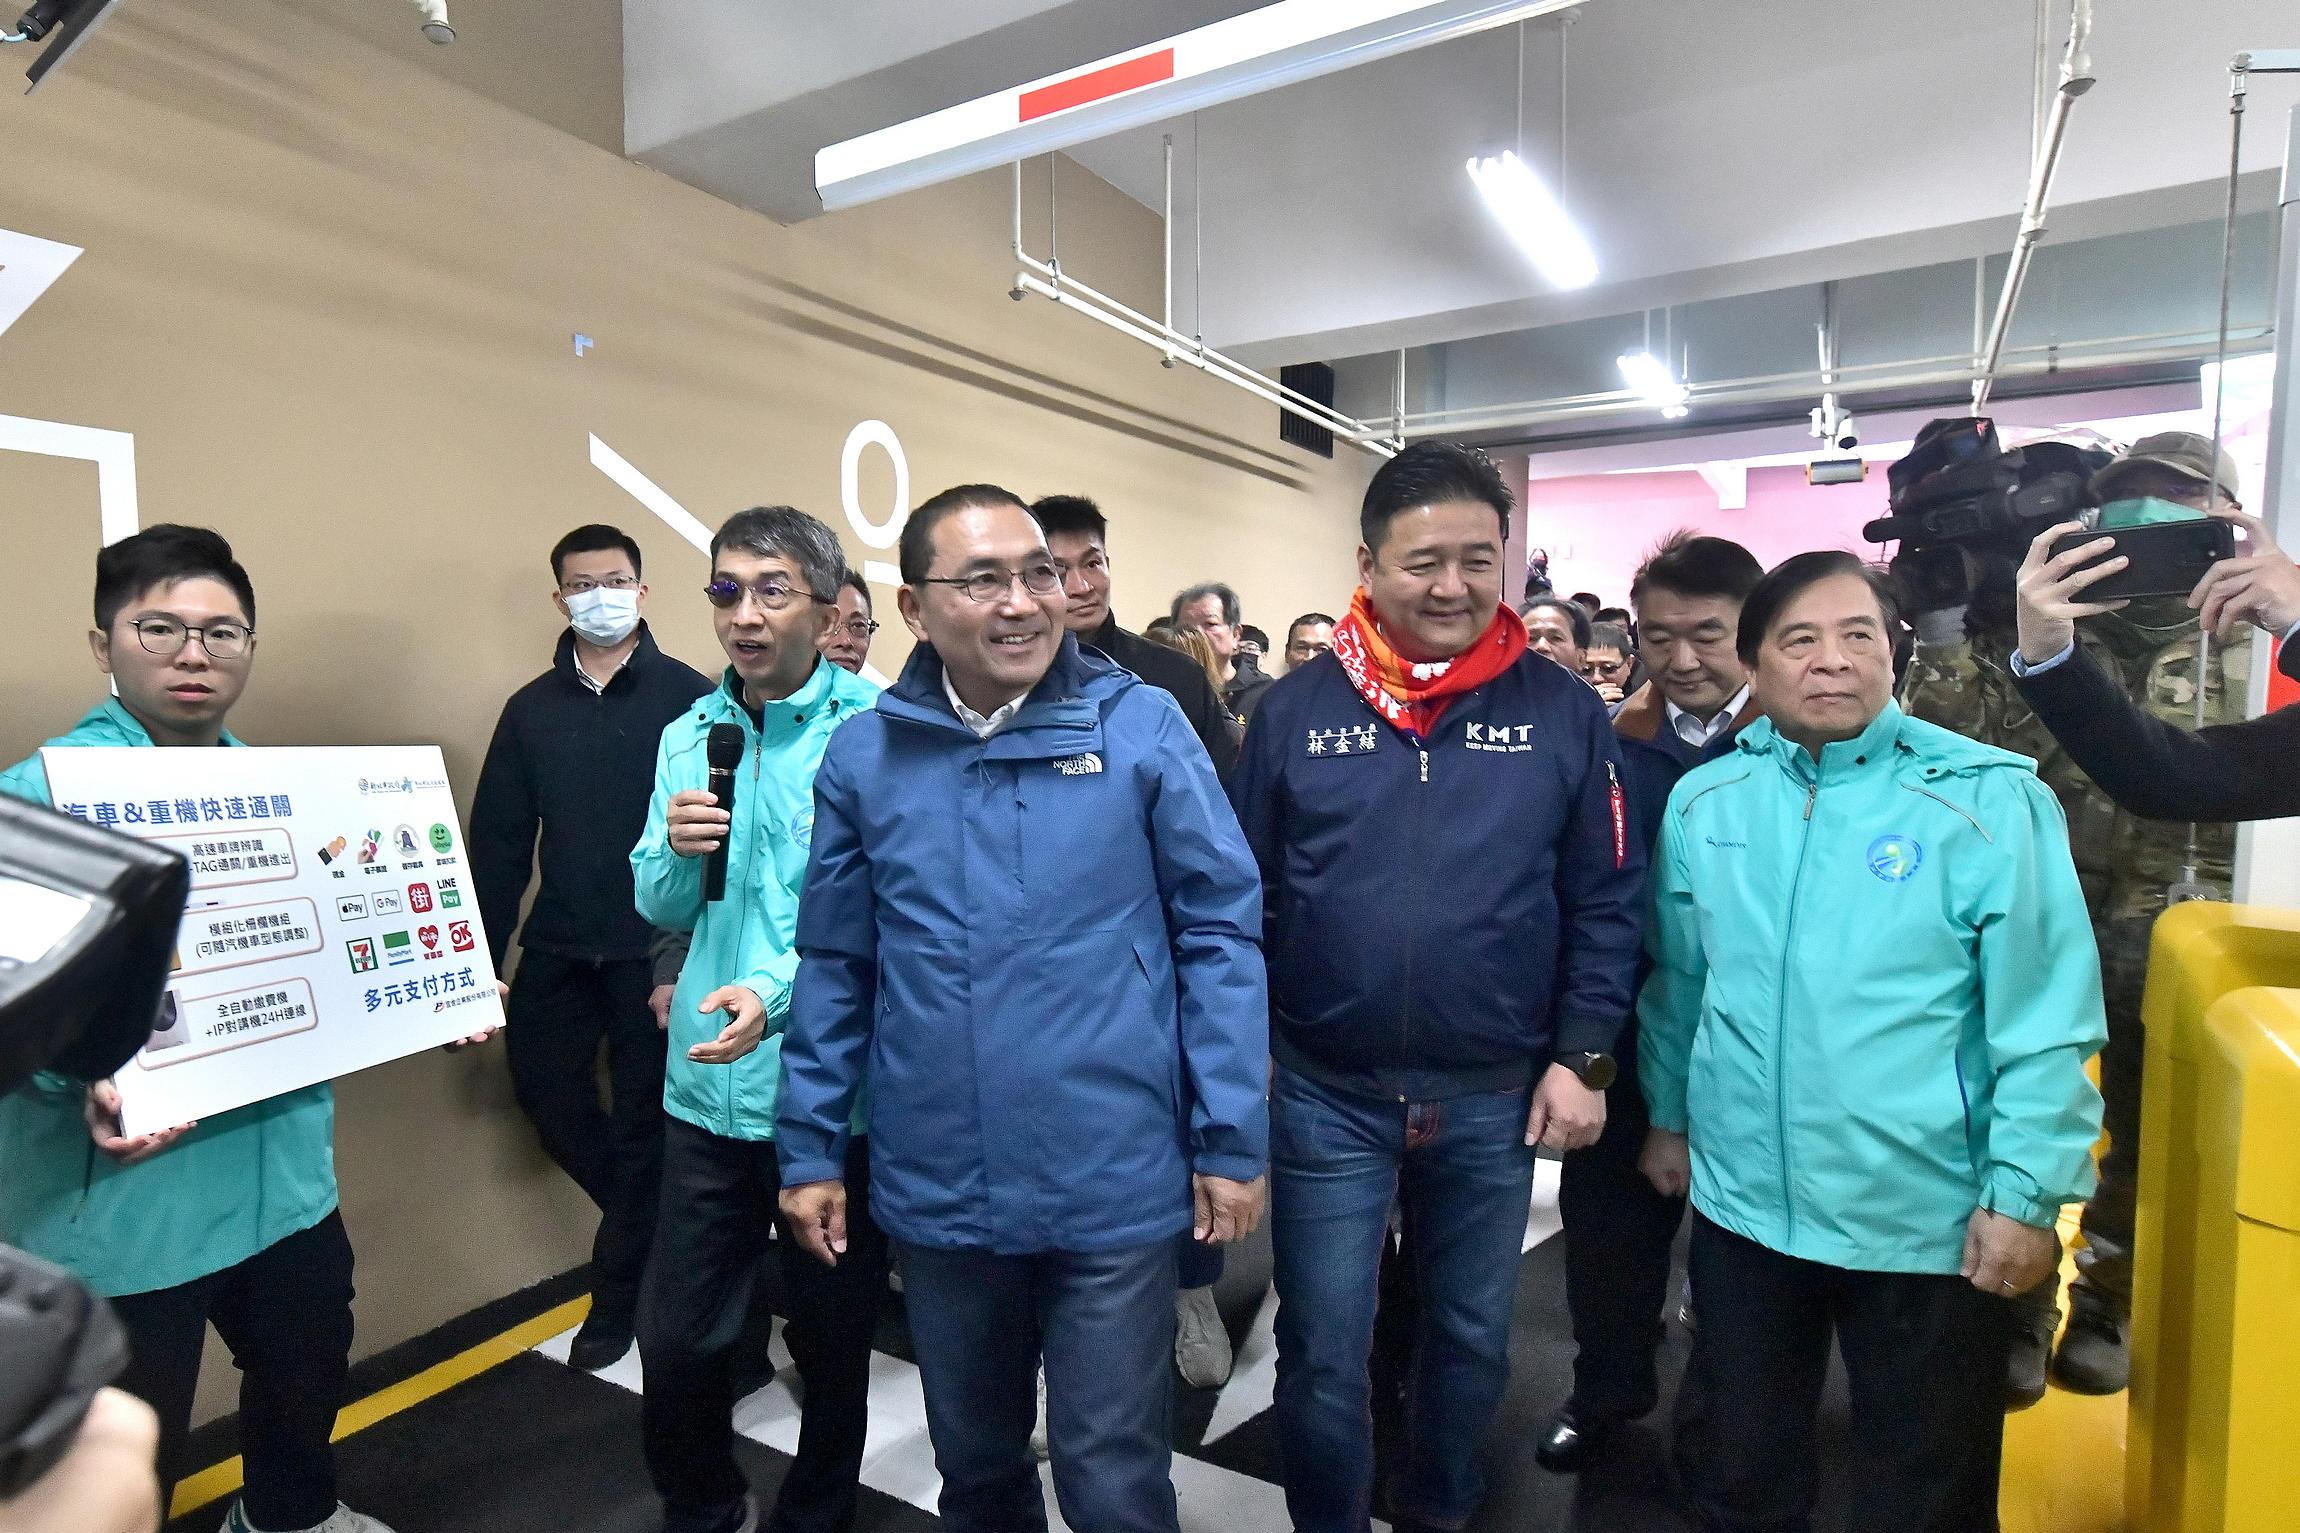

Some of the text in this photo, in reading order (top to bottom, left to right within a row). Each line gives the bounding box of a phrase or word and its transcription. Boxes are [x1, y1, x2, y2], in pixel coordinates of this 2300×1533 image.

[1466, 721, 1534, 743] KMT
[1307, 732, 1377, 755] 林金結
[1465, 741, 1533, 752] KEEP MOVING TAIWAN
[1053, 760, 1085, 769] NORTH
[1062, 766, 1086, 775] FACE
[437, 878, 457, 889] LINE
[348, 902, 364, 914] Pay
[385, 897, 399, 908] Pay
[410, 886, 430, 909] 街
[443, 894, 458, 905] Pay
[208, 912, 292, 937] 模組化柵欄機組
[451, 923, 472, 945] OK
[364, 966, 476, 1014] 多元支付方式
[216, 991, 289, 1019] 全自動繳費機
[204, 1004, 308, 1038] +IP對講機24H連線
